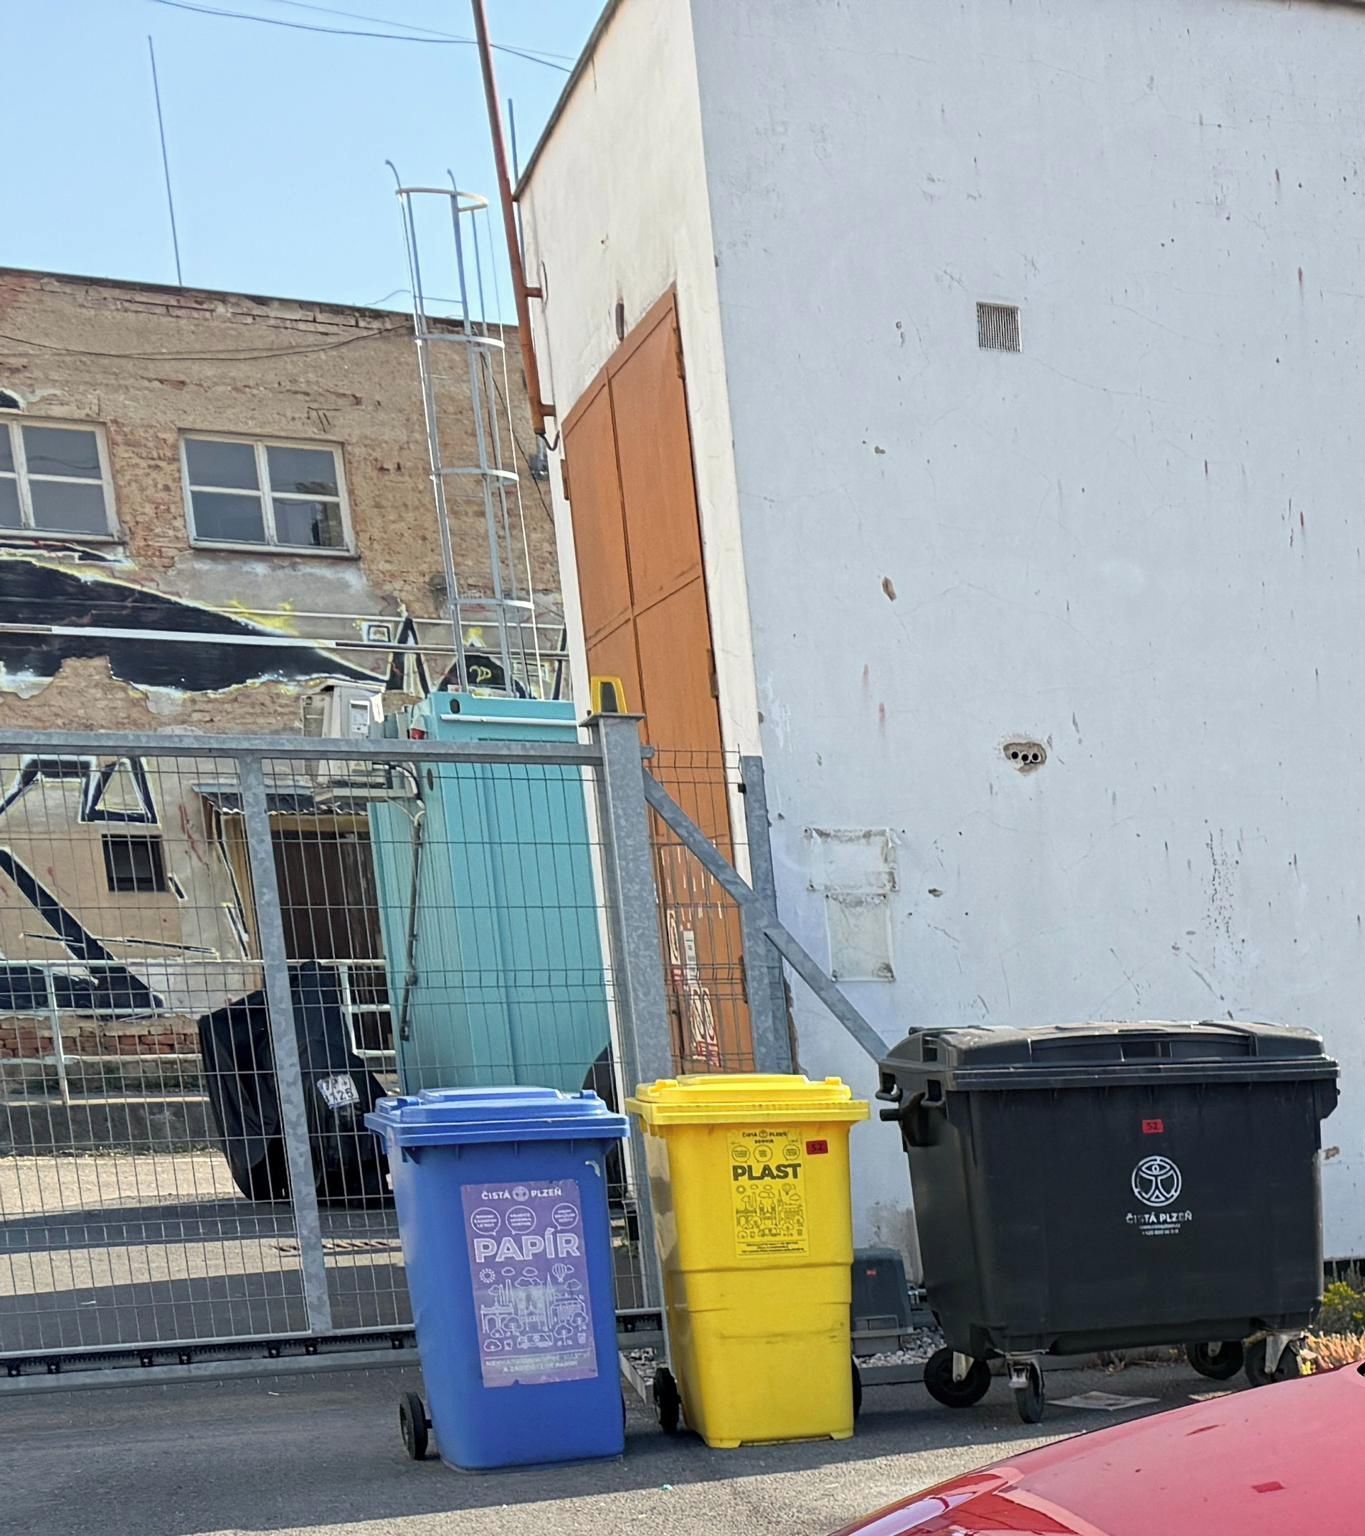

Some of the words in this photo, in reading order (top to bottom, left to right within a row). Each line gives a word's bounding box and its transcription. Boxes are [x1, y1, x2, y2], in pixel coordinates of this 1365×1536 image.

[732, 1162, 802, 1182] PLAST
[481, 1189, 512, 1200] ČISTÁ
[530, 1186, 562, 1198] PLZEŇ
[473, 1227, 581, 1263] PAPÍR
